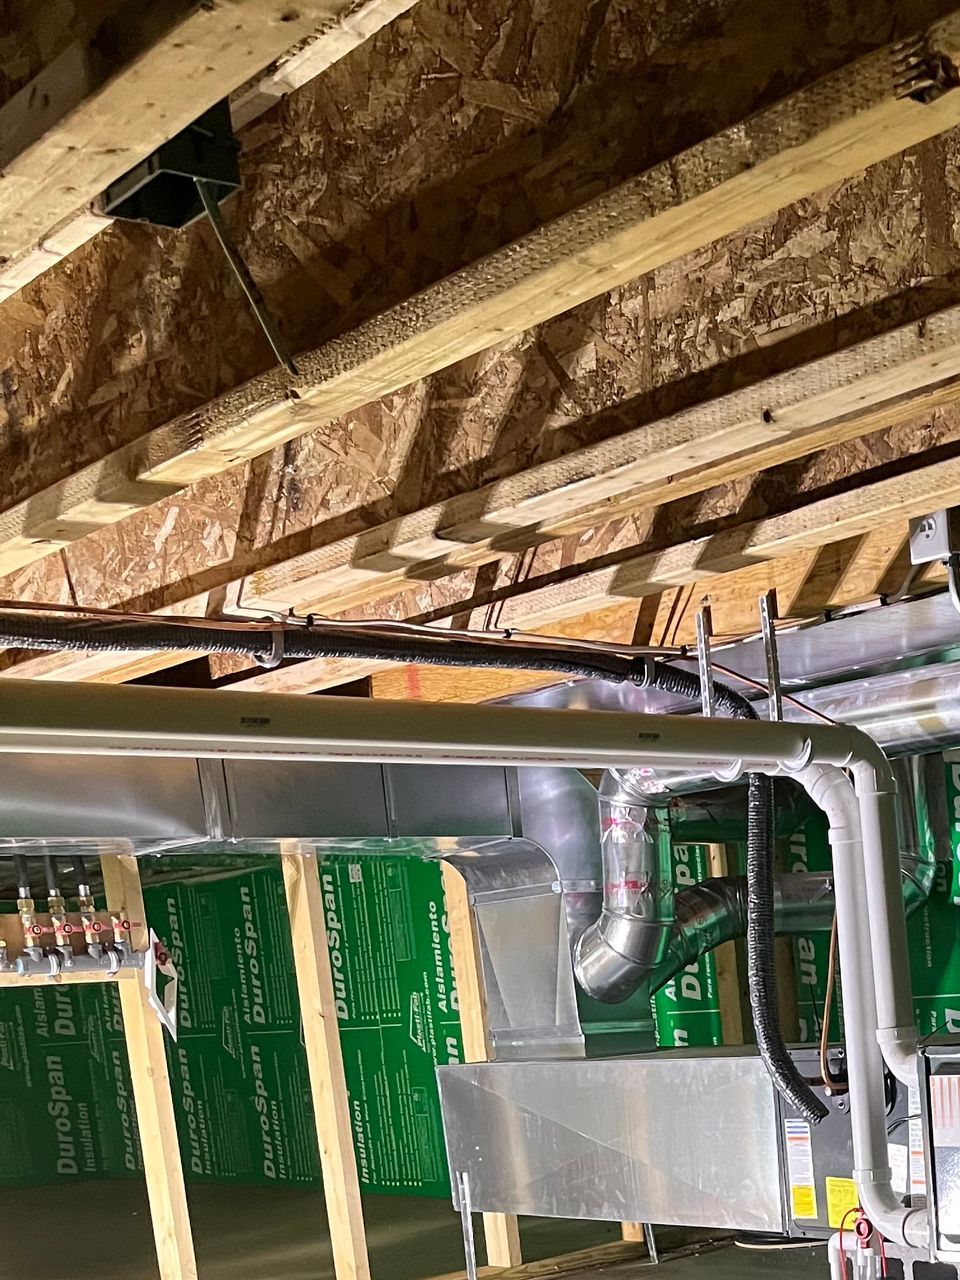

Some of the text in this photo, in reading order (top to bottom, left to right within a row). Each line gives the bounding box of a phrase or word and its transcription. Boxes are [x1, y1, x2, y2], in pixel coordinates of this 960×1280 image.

[167, 898, 192, 1028] DuroSpan
[233, 927, 251, 1024] Aislamiento
[240, 886, 265, 1024] DuroSpan
[322, 874, 349, 1019] DuroSpan
[428, 901, 448, 1013] Aislamiento
[45, 1055, 79, 1174] DuroSpan
[77, 1103, 97, 1172] Insulation
[112, 1051, 135, 1170] DuroSpan
[178, 1048, 203, 1174] DuroSpan
[197, 1100, 212, 1175] Insulation
[250, 1045, 277, 1179] DuroSpan
[270, 1100, 286, 1179] Insulation
[352, 1100, 370, 1184] Insulation
